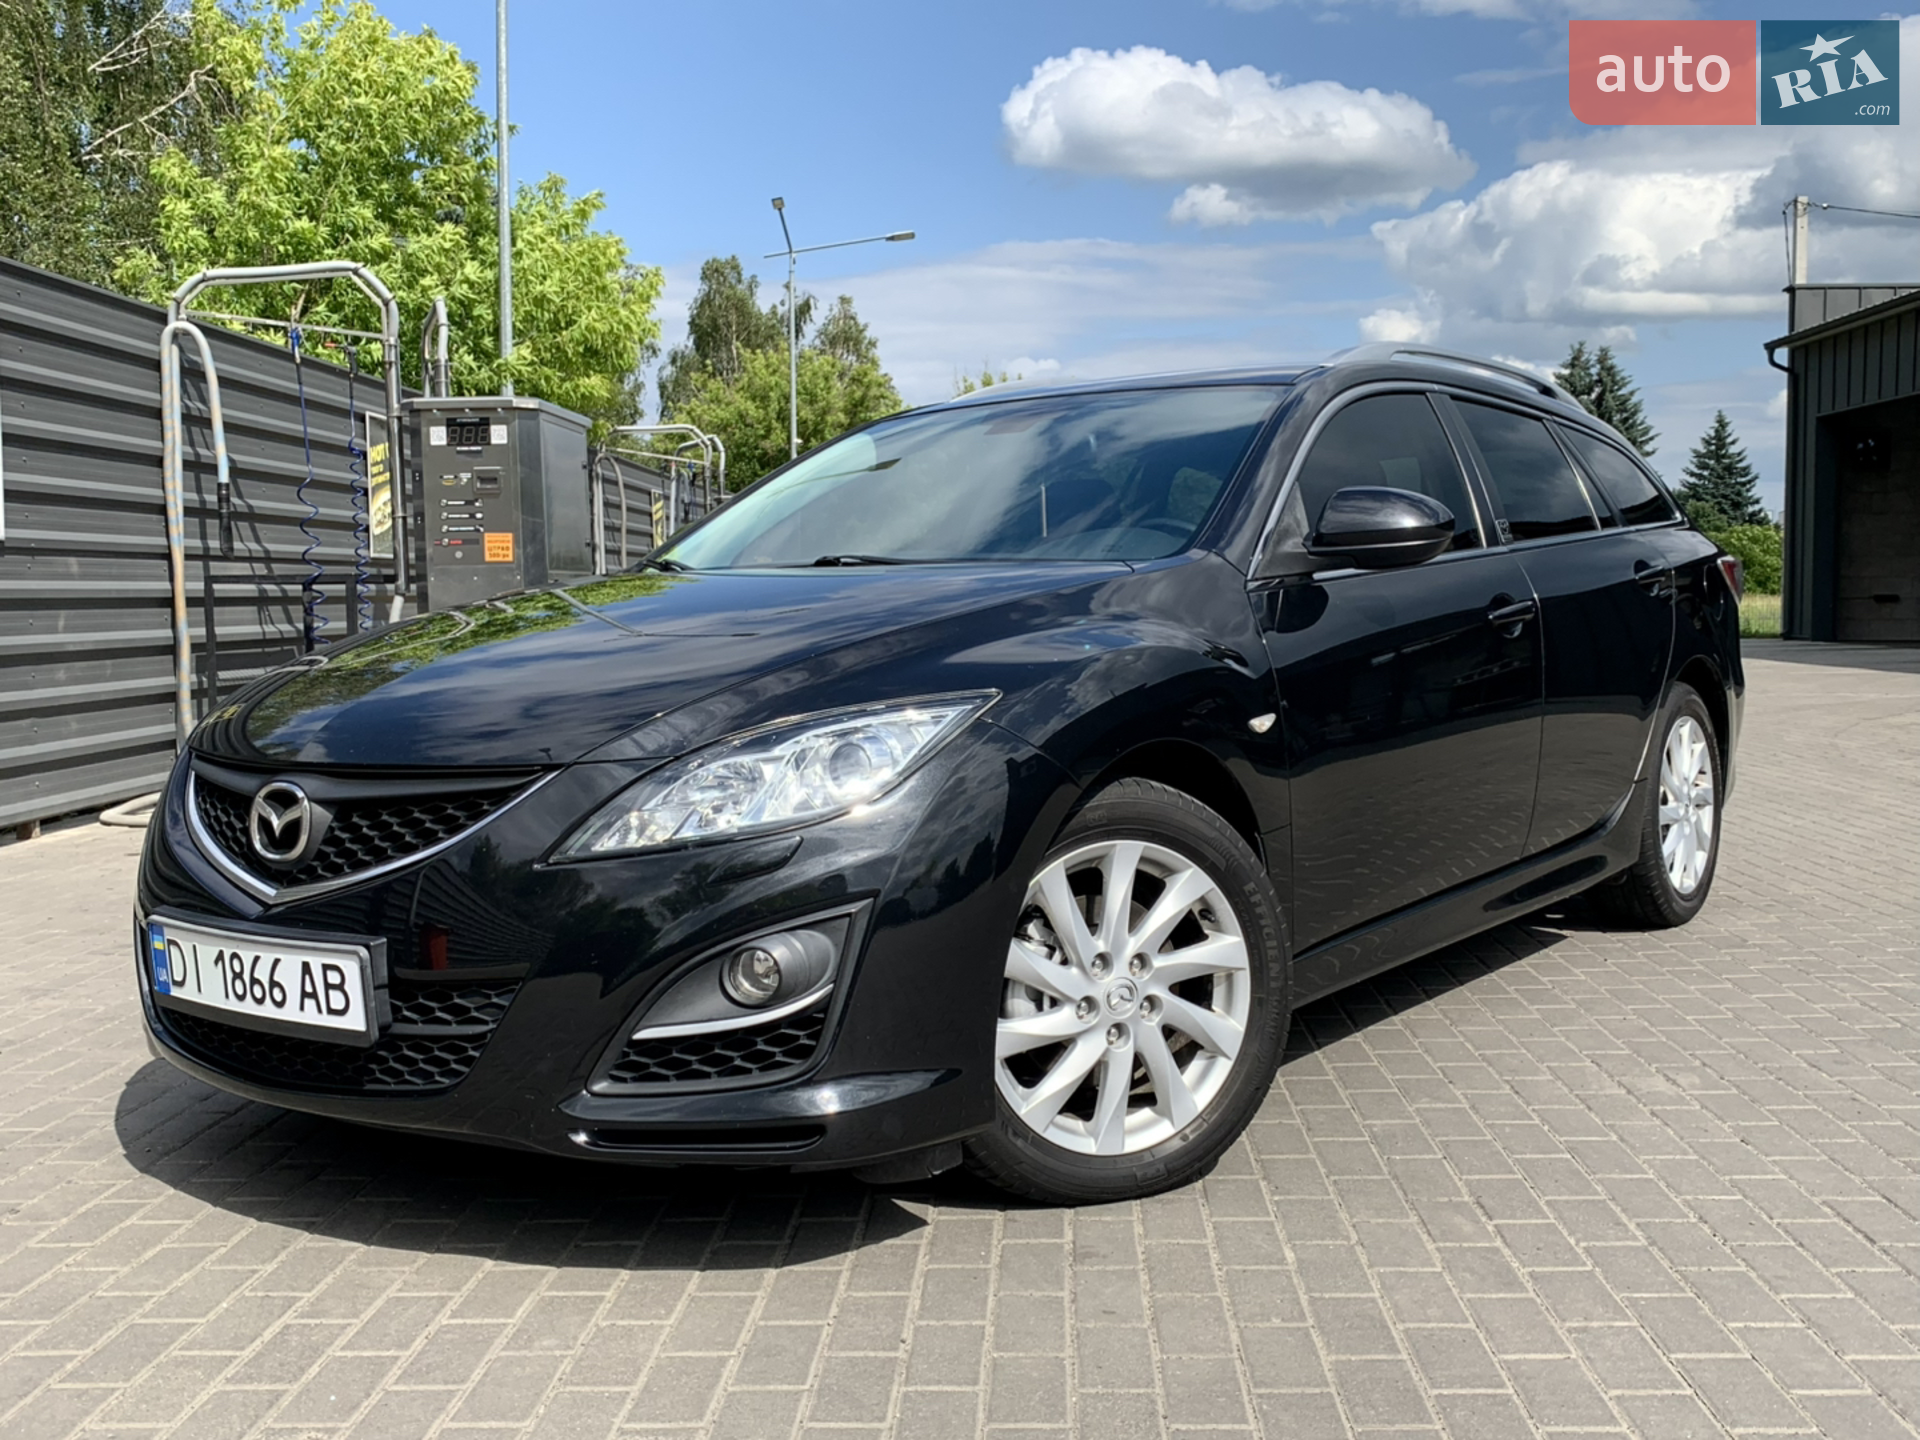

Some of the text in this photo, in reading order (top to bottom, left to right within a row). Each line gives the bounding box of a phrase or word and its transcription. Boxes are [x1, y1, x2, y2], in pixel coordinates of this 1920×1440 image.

[158, 967, 168, 983] UA
[166, 938, 351, 1017] DI 1866 AB
